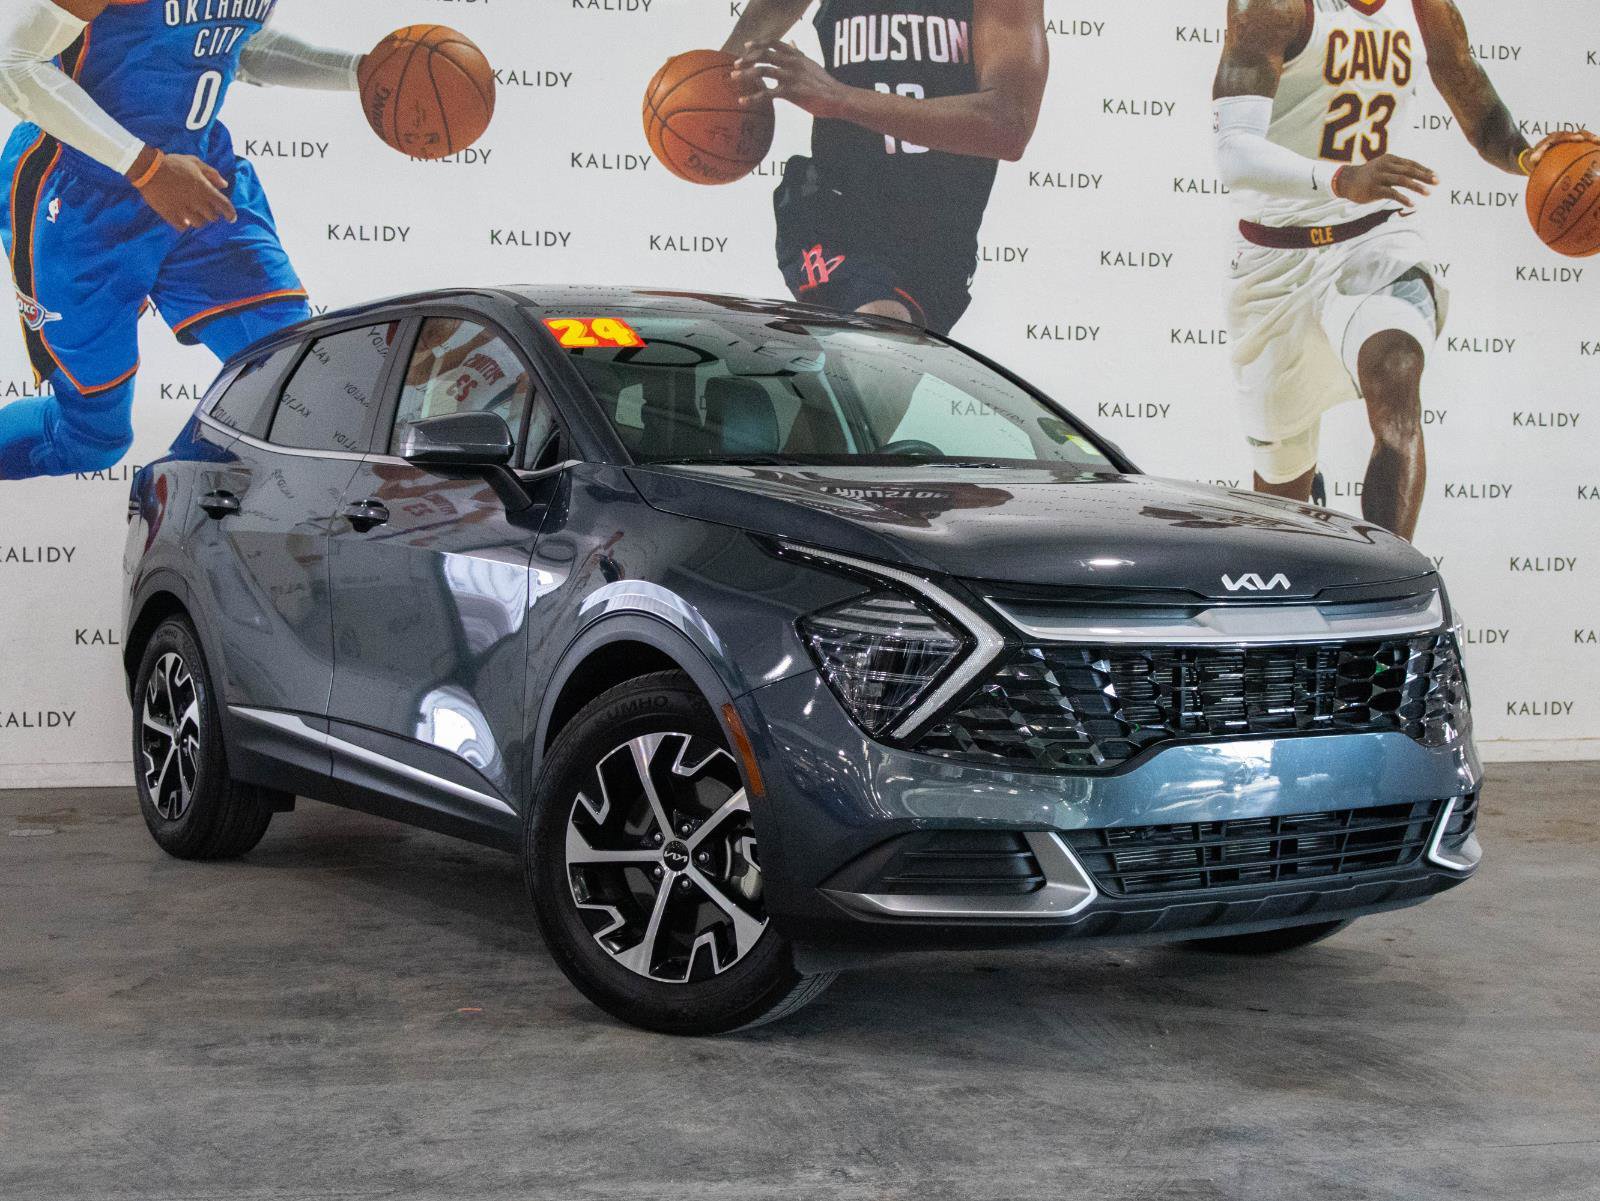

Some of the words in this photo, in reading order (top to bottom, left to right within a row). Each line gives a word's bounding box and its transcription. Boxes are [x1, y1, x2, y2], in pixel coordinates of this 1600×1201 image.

[1046, 20, 1105, 37] ALIDY
[194, 26, 245, 57] CITY
[833, 14, 969, 68] HOUSTON
[1324, 29, 1411, 87] CAVS
[186, 71, 222, 130] 0
[1104, 99, 1176, 117] KALIDY
[1319, 92, 1397, 162] 23
[245, 140, 329, 159] KALIDY
[571, 153, 652, 170] KALIDY
[1030, 172, 1103, 189] KALIDY
[1451, 190, 1519, 207] KALIDY
[328, 224, 411, 243] KALIDY
[491, 230, 572, 248] KALIDY
[650, 235, 728, 253] KALIDY
[1101, 251, 1174, 268] KALIDY
[1517, 267, 1584, 283] KALIDY
[1027, 325, 1101, 341] KALIDY
[1171, 329, 1227, 345] KALID
[1448, 337, 1516, 353] KALIDY
[1098, 402, 1171, 419] KALIDY
[1513, 412, 1580, 428] KALIDY
[1445, 484, 1513, 499] KALIDY
[1510, 557, 1577, 572] KALIDY
[1507, 702, 1574, 716] KALIDY
